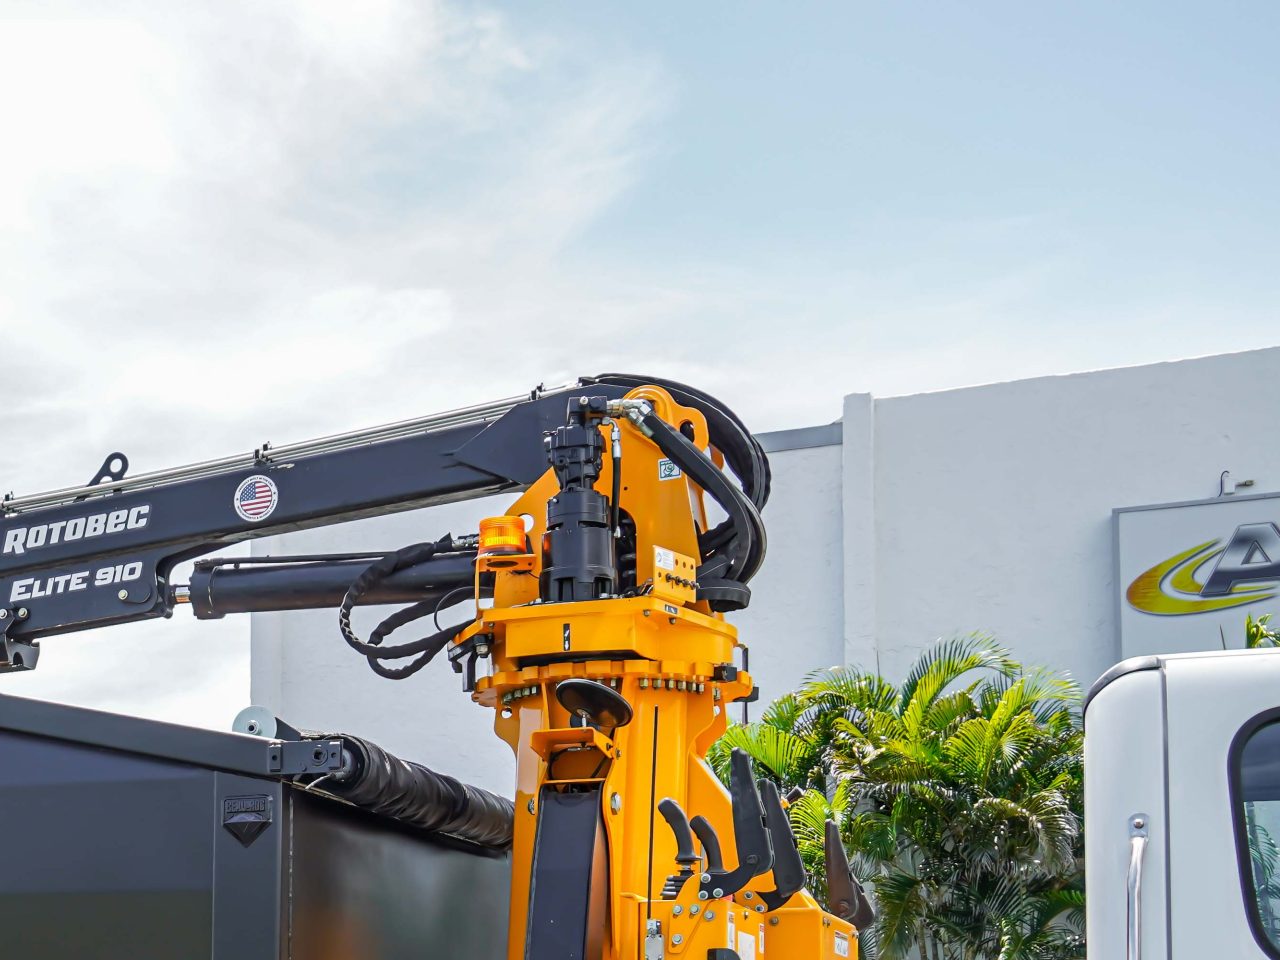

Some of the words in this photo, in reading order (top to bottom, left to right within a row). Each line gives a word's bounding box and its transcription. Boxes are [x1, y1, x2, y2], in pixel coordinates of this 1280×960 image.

[2, 505, 151, 555] ROTOBEC
[9, 570, 90, 602] ELITE
[94, 561, 143, 587] 910
